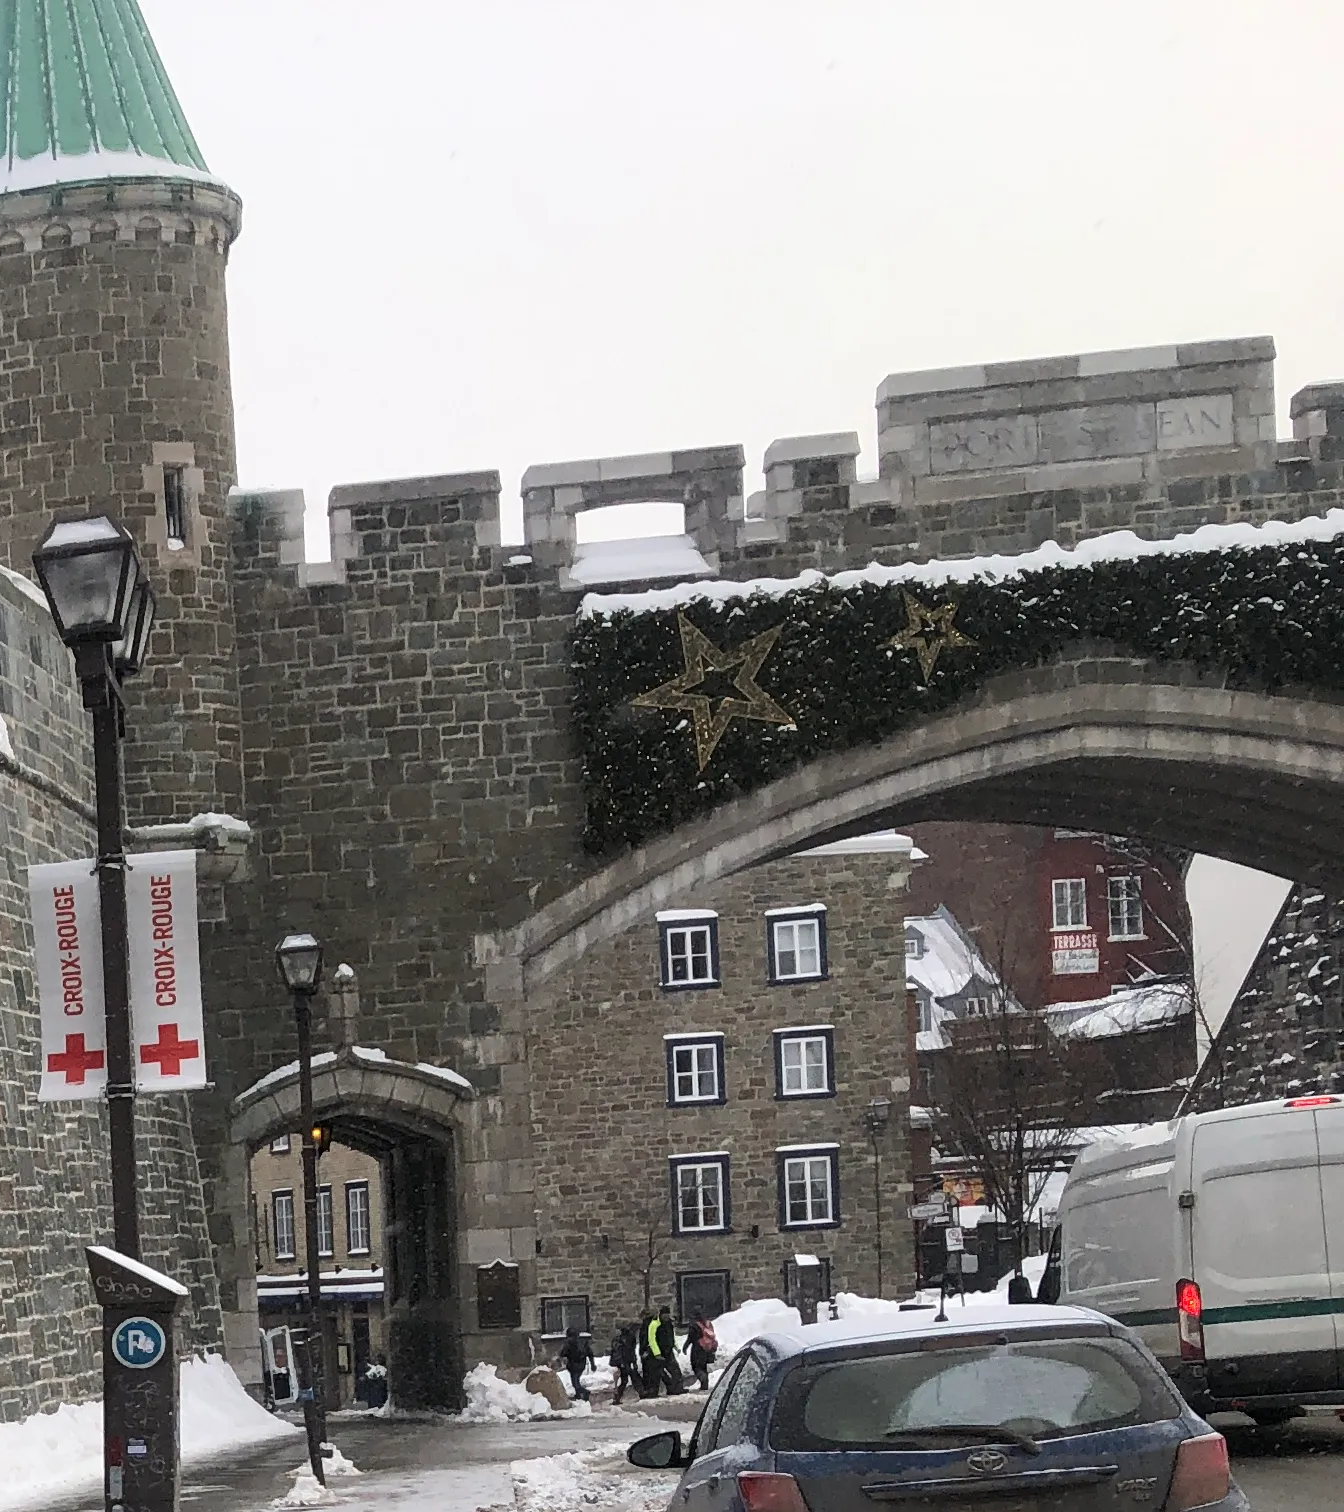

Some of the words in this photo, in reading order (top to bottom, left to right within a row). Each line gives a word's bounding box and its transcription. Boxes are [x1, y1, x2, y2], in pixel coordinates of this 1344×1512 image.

[53, 885, 84, 1016] CROIX-ROUGE
[151, 874, 176, 1006] CROIX-ROUGE
[1053, 933, 1097, 949] TERRASSE
